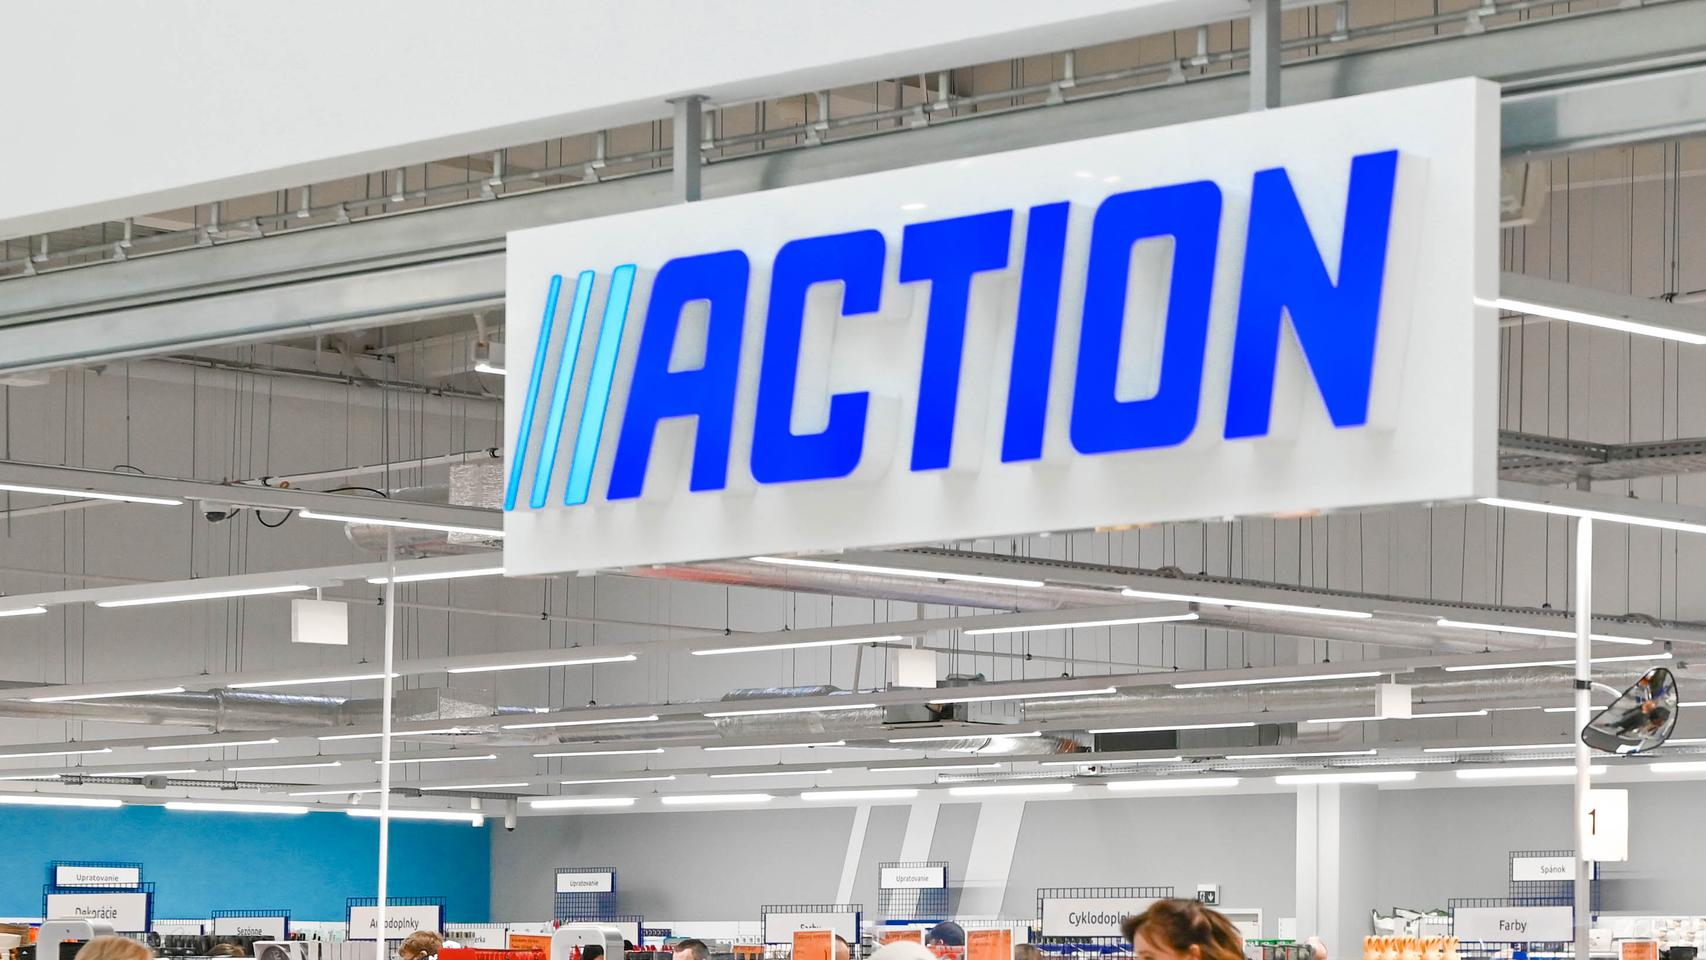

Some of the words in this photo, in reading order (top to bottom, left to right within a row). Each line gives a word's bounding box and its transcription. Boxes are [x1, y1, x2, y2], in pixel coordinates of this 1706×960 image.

[606, 149, 1398, 501] ACTION
[1588, 808, 1596, 836] 1
[1540, 864, 1566, 875] Spánok
[76, 874, 119, 883] Upratovanie
[569, 879, 599, 888] Upratovanie
[896, 875, 929, 883] Upratovanie
[369, 917, 420, 932] Aodoplnky
[1068, 911, 1135, 926] Cyklodopln
[236, 926, 262, 936] Sezónne
[1499, 919, 1528, 932] Farby
